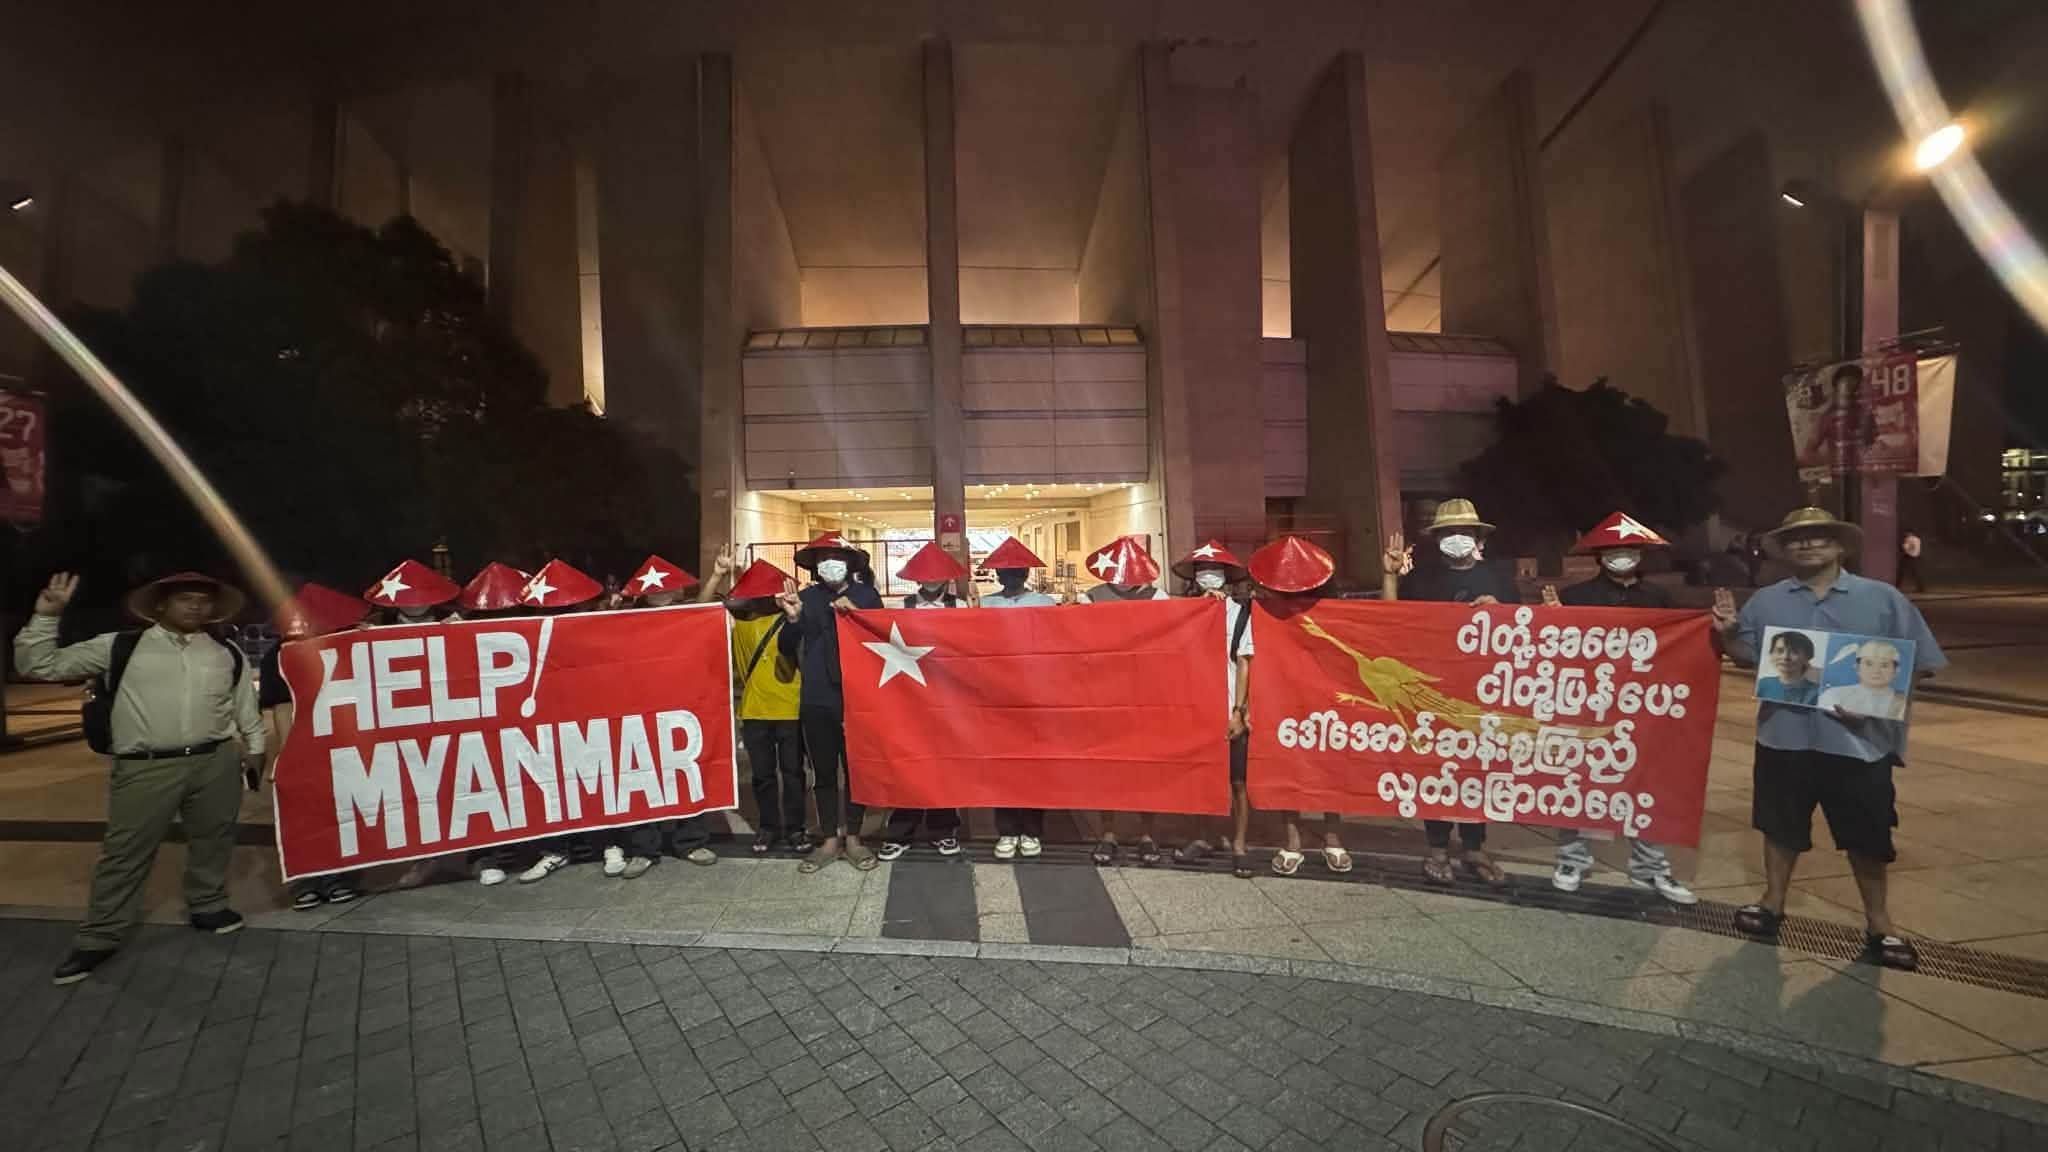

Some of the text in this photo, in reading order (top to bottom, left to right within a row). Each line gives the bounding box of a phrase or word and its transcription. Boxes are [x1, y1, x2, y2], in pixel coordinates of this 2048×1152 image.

[1872, 365, 1910, 397] 48
[312, 616, 553, 737] HELP!
[330, 710, 705, 858] MYANMAR
